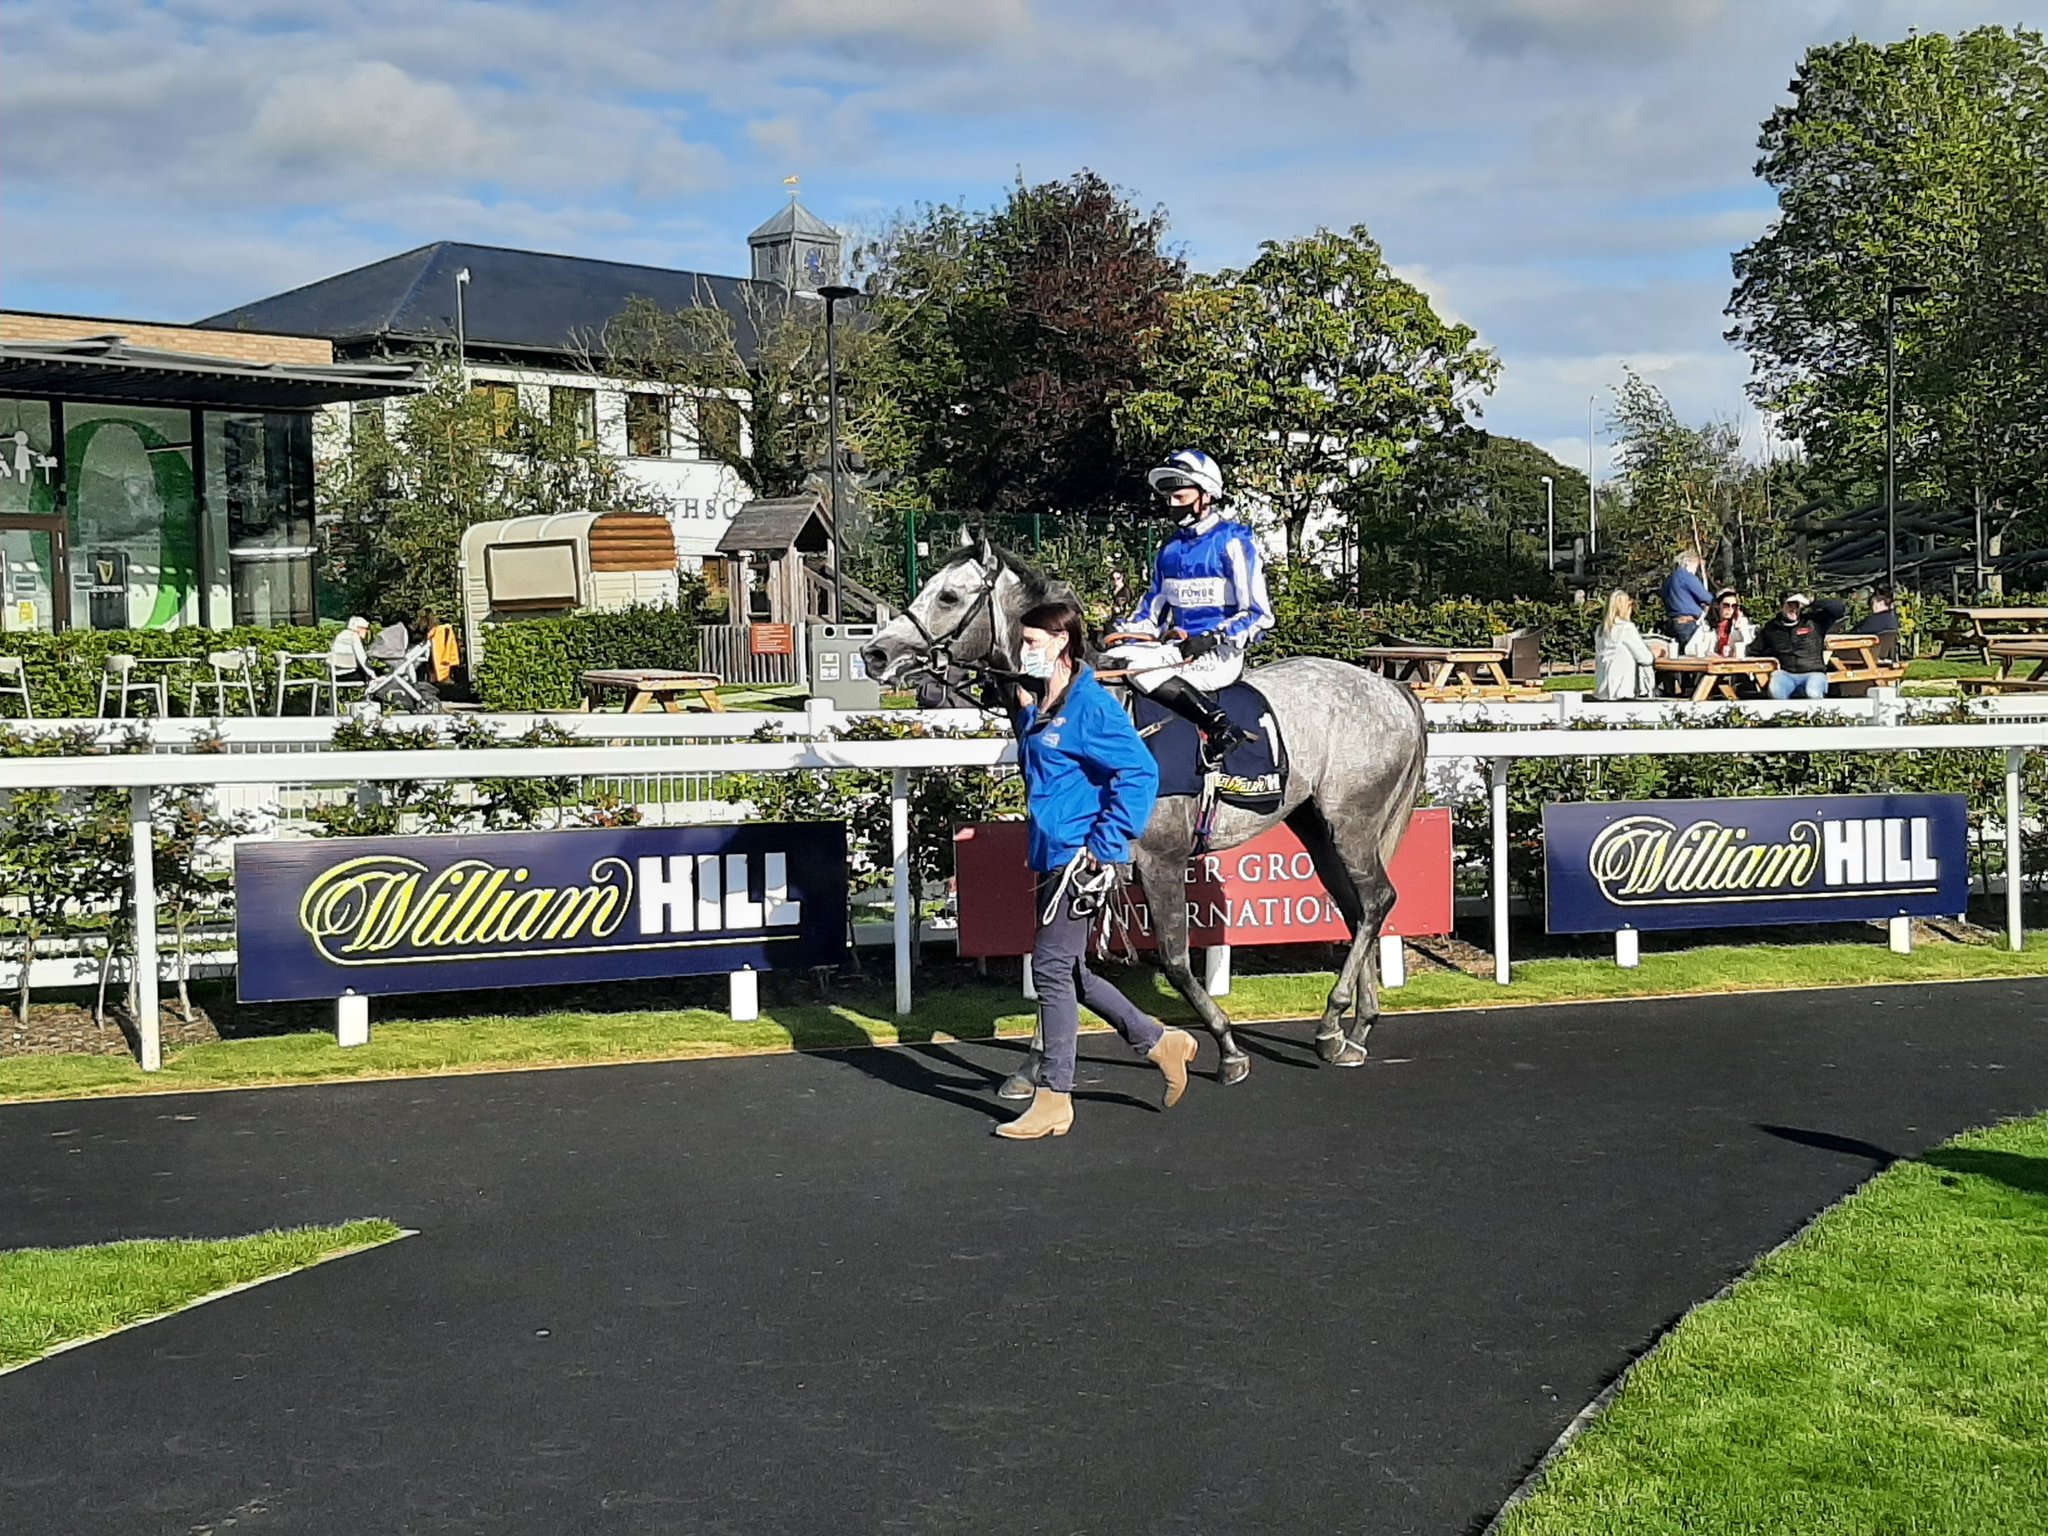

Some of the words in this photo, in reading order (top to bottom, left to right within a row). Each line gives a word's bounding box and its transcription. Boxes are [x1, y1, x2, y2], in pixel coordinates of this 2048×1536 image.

[1258, 712, 1279, 767] 1
[1238, 852, 1315, 883] GRO
[1588, 815, 1821, 896] William
[1823, 817, 1937, 886] HILL
[300, 855, 633, 954] William
[637, 852, 800, 935] HILL
